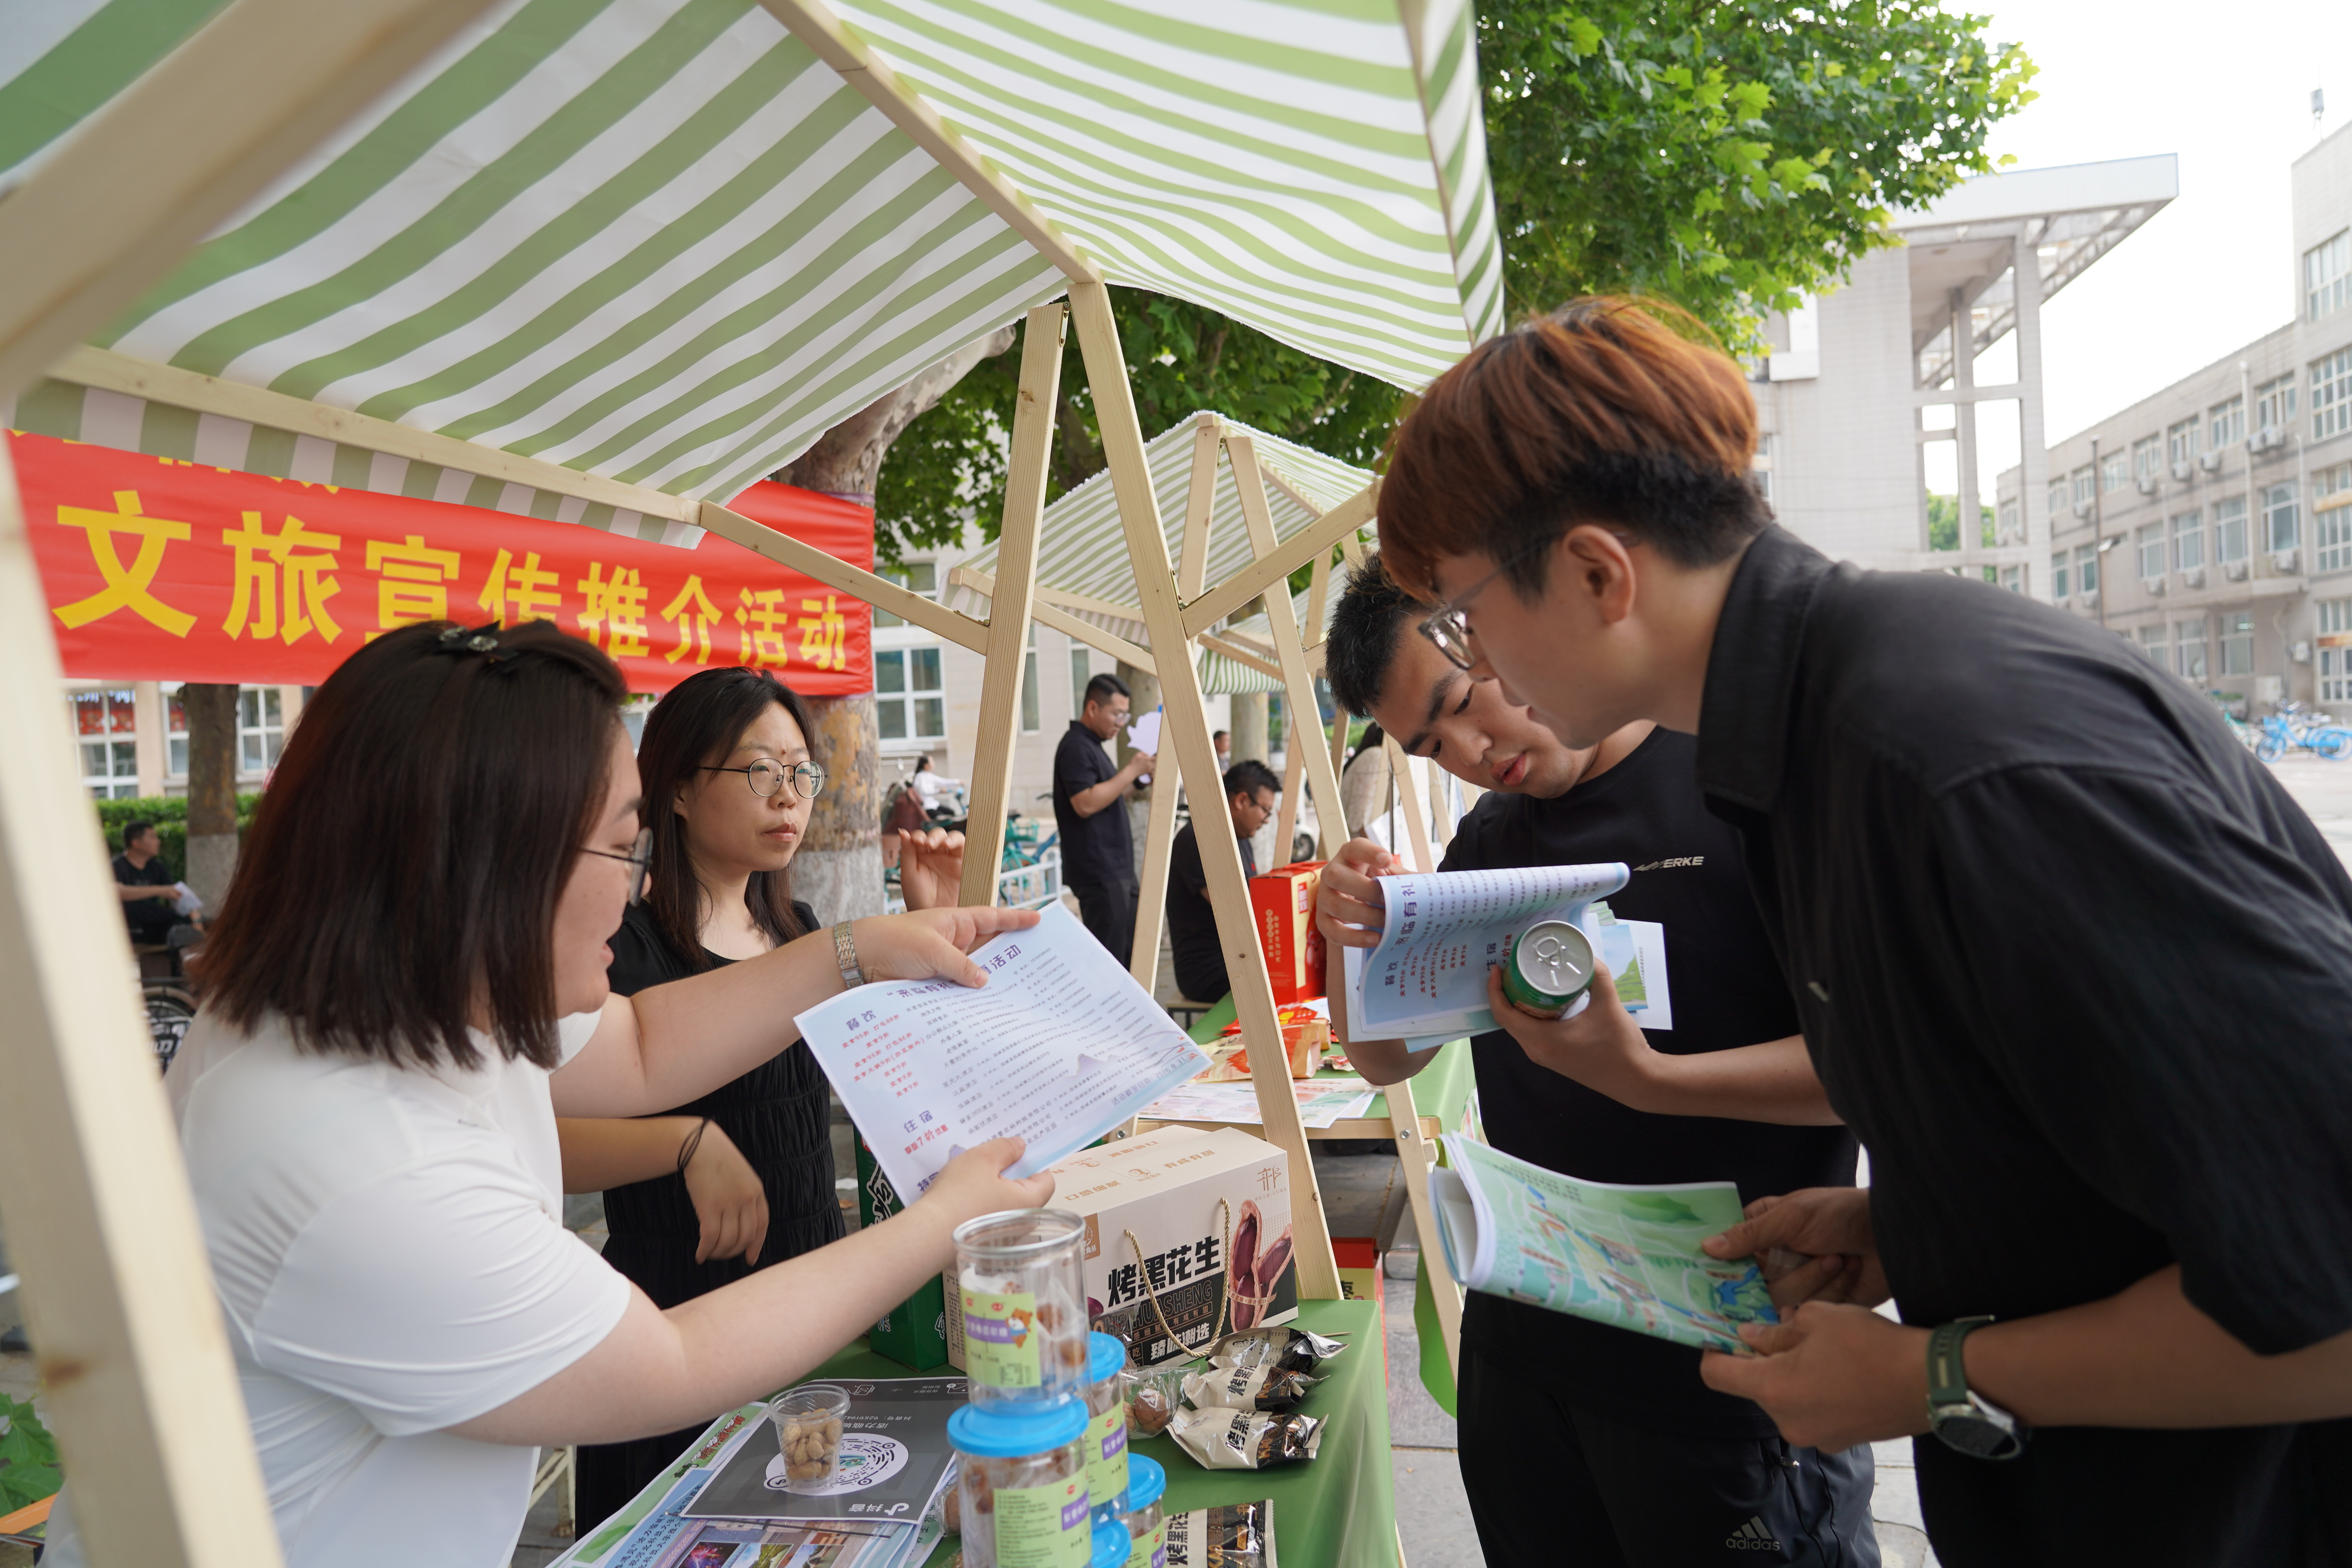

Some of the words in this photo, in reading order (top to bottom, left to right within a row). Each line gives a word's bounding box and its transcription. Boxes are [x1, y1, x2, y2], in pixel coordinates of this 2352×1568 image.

[53, 490, 847, 672] 文旅宣传推介活动
[1662, 856, 1704, 868] ERKE
[846, 1008, 877, 1031] 餐饮
[841, 1029, 870, 1049] 堂食95折
[865, 1031, 890, 1048] 堂食9折
[854, 1049, 882, 1068] 堂食95折
[884, 1060, 907, 1077] 堂食9折
[889, 1071, 913, 1088] 堂食8折
[896, 1080, 919, 1097] 堂食9折
[902, 1109, 933, 1134] 住宿
[1083, 1244, 1096, 1255] 食品
[1107, 1235, 1220, 1309] 烤黑花生
[848, 1503, 884, 1512] 抖音
[1726, 1537, 1780, 1551] adidas
